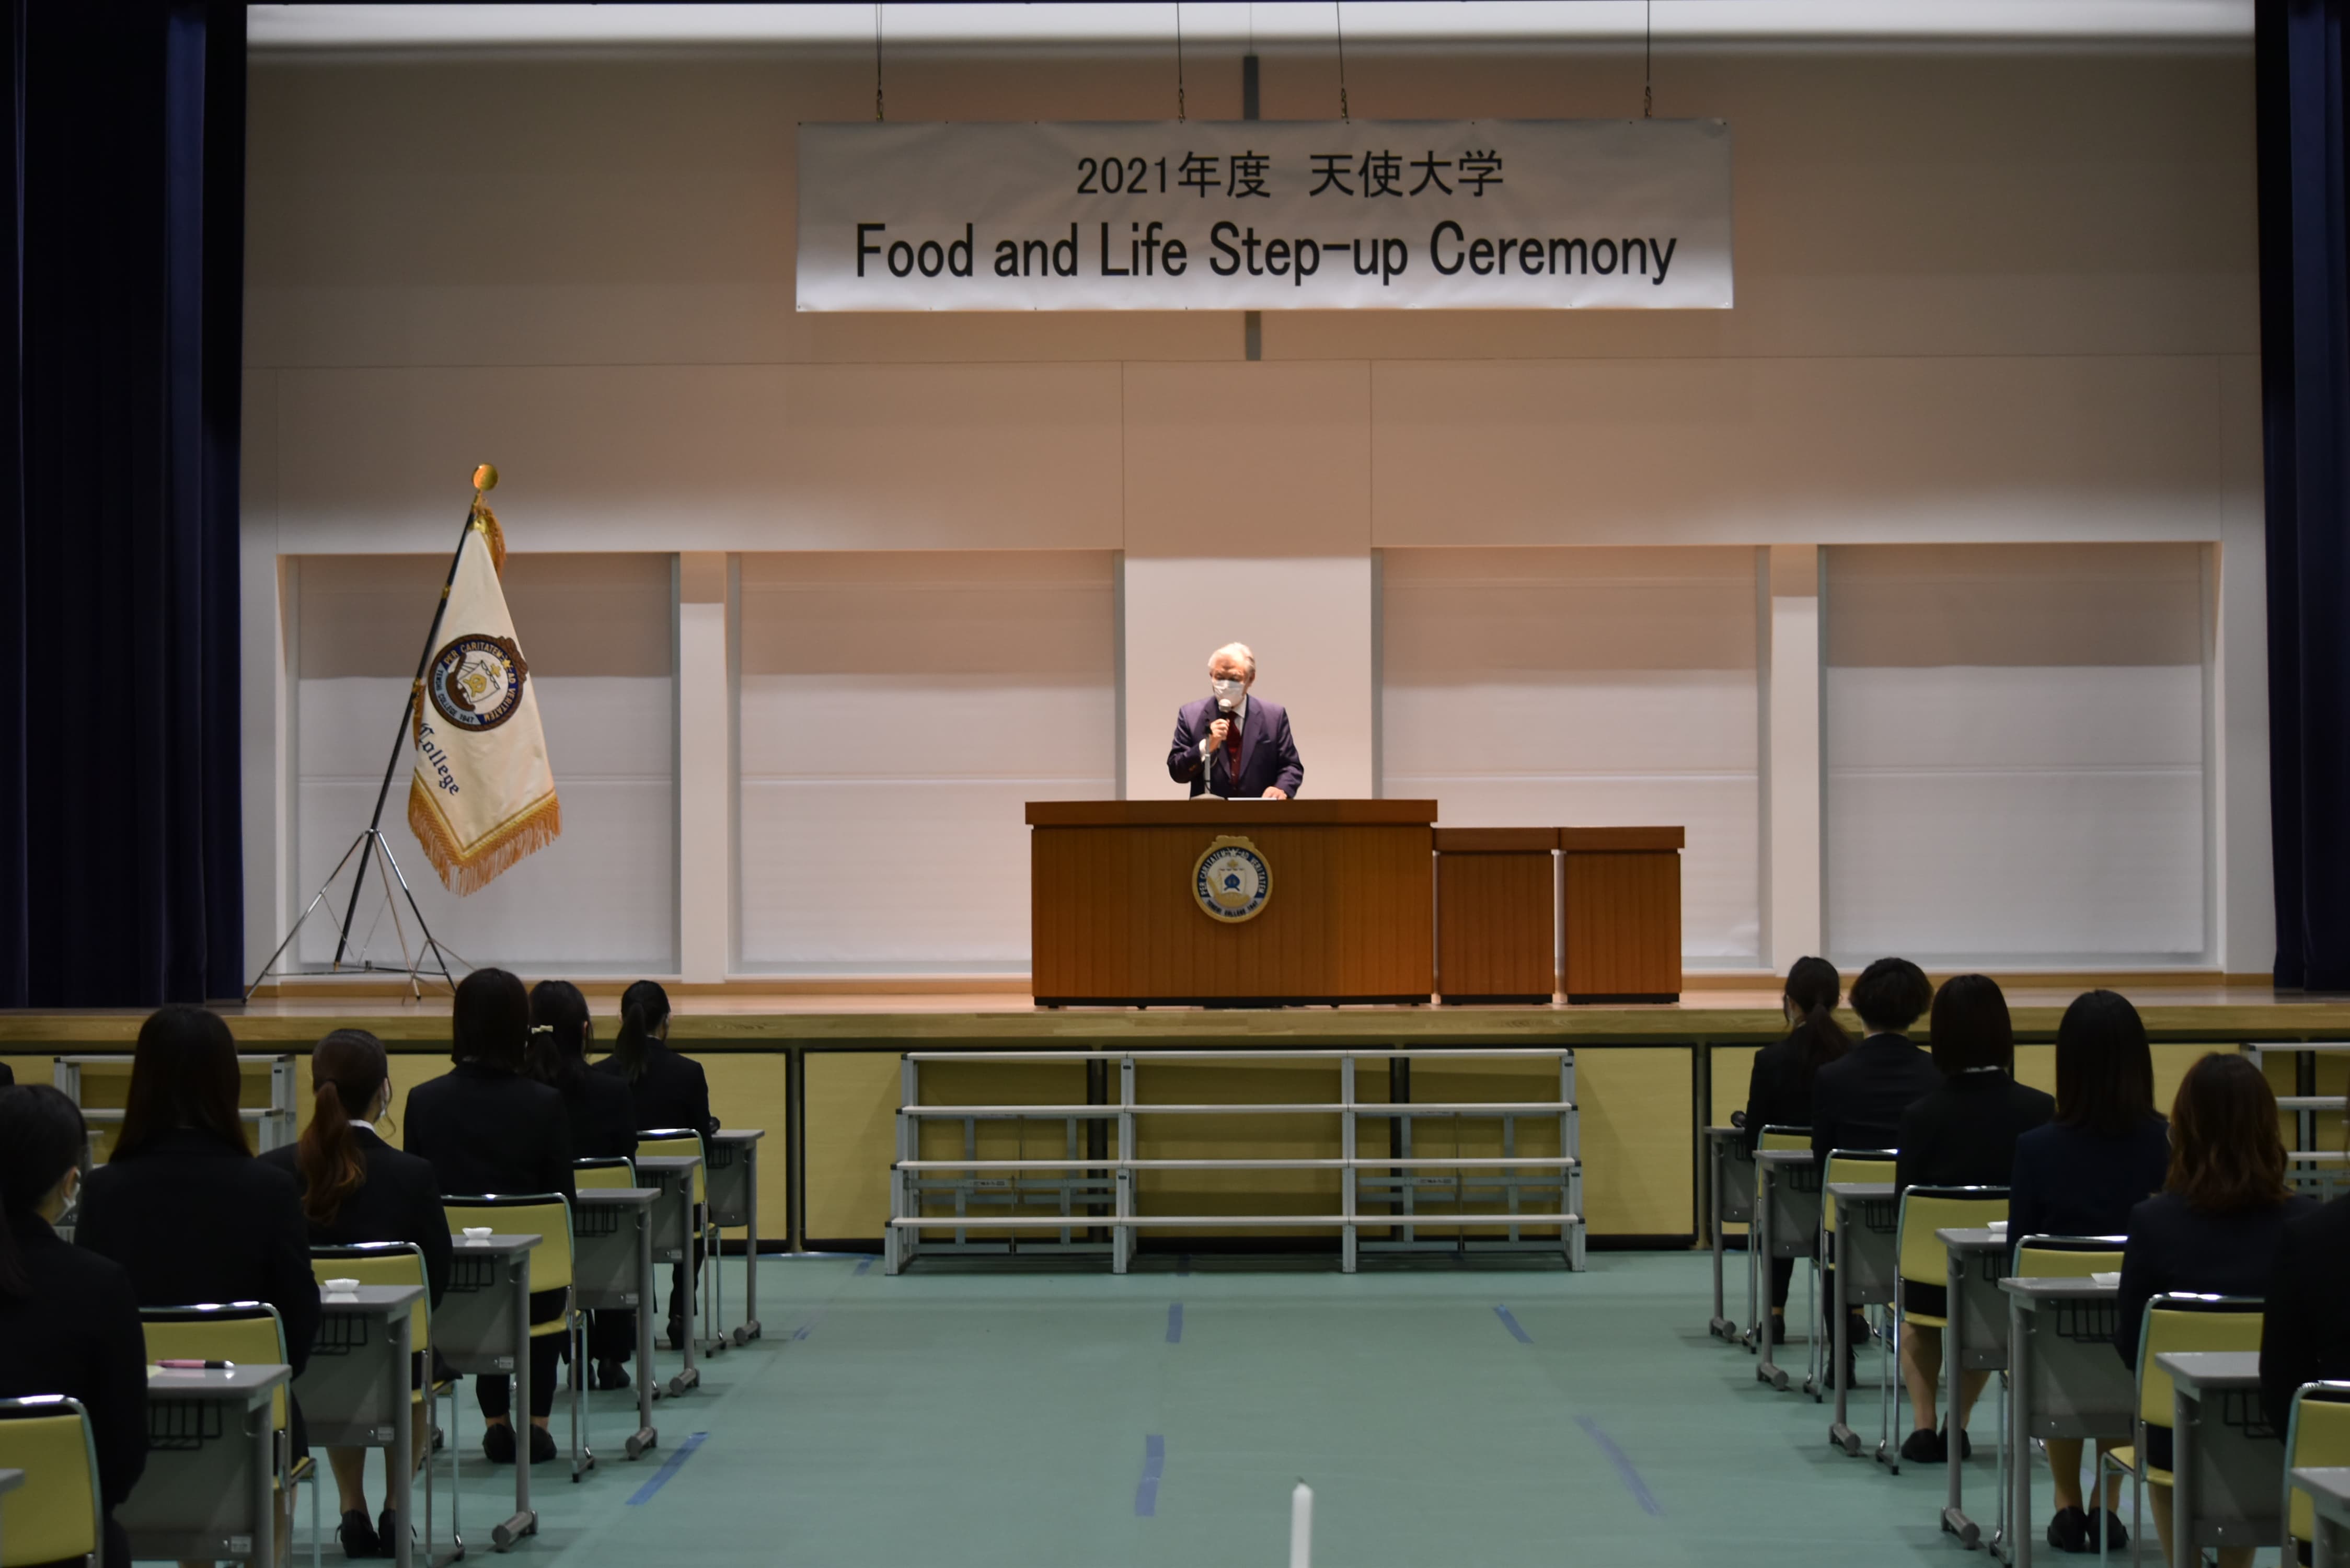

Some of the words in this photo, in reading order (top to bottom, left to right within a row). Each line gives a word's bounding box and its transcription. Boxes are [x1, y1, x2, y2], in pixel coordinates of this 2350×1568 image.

[1077, 150, 1271, 199] 2021年度
[1309, 149, 1503, 198] 天使大学
[857, 222, 973, 278] Food
[994, 222, 1078, 277] and
[1101, 221, 1187, 276] Life
[1209, 221, 1408, 286] Step-up
[1430, 221, 1677, 286] Ceremony
[444, 650, 459, 664] PER
